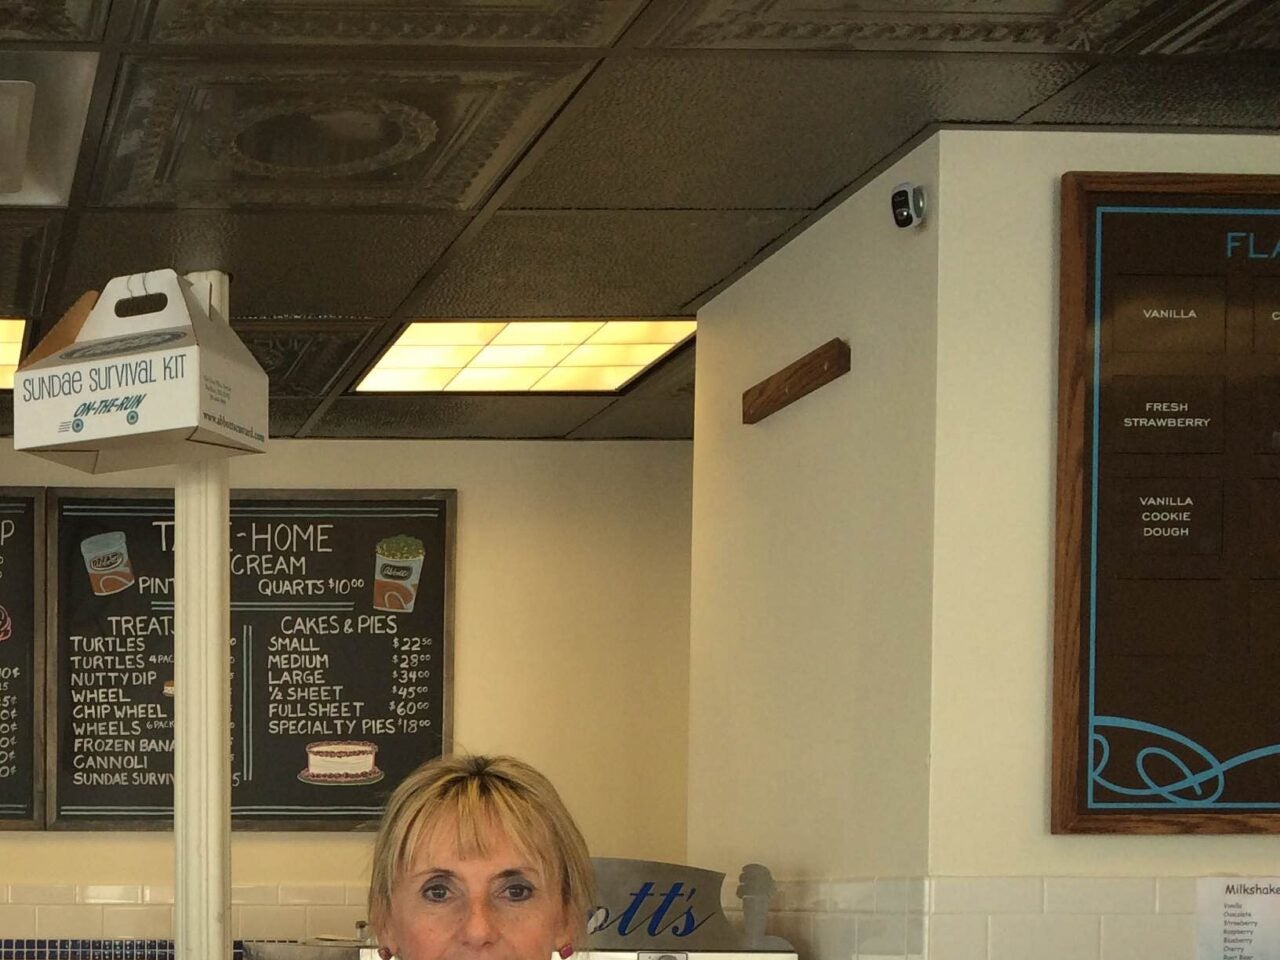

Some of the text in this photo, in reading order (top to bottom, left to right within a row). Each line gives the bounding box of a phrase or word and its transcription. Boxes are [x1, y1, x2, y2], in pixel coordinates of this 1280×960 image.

[1143, 309, 1197, 319] VANILLA
[163, 354, 186, 380] KIT
[73, 393, 147, 418] ON-THE-RUN
[1145, 402, 1188, 412] FRESH
[1123, 417, 1211, 427] STRAWBERRY
[1139, 496, 1193, 506] VANILLA
[1141, 512, 1191, 522] COOKIE
[1143, 527, 1189, 537] DOUGH
[231, 554, 305, 575] CREAM
[258, 579, 324, 596] QUARTS
[107, 616, 174, 636] TREAT
[281, 615, 398, 635] CAKES & PIES
[70, 636, 145, 652] TURTLES
[268, 636, 320, 651] SMALL
[70, 654, 157, 669] TURTLES 4
[268, 654, 329, 668] MEDIUM
[71, 671, 157, 686] NUTTY DIP
[269, 669, 325, 684] LARGE
[72, 688, 131, 702] WHEEL
[287, 686, 343, 700] SHEET
[73, 704, 167, 719] CHIP WHEEL
[73, 721, 141, 736] WHEELS
[268, 719, 395, 735] SPECIALTY PIES
[74, 738, 135, 752] FROZEN
[73, 755, 148, 769] CANNOLI
[73, 772, 128, 785] SUNDAE
[587, 881, 716, 937] ott's
